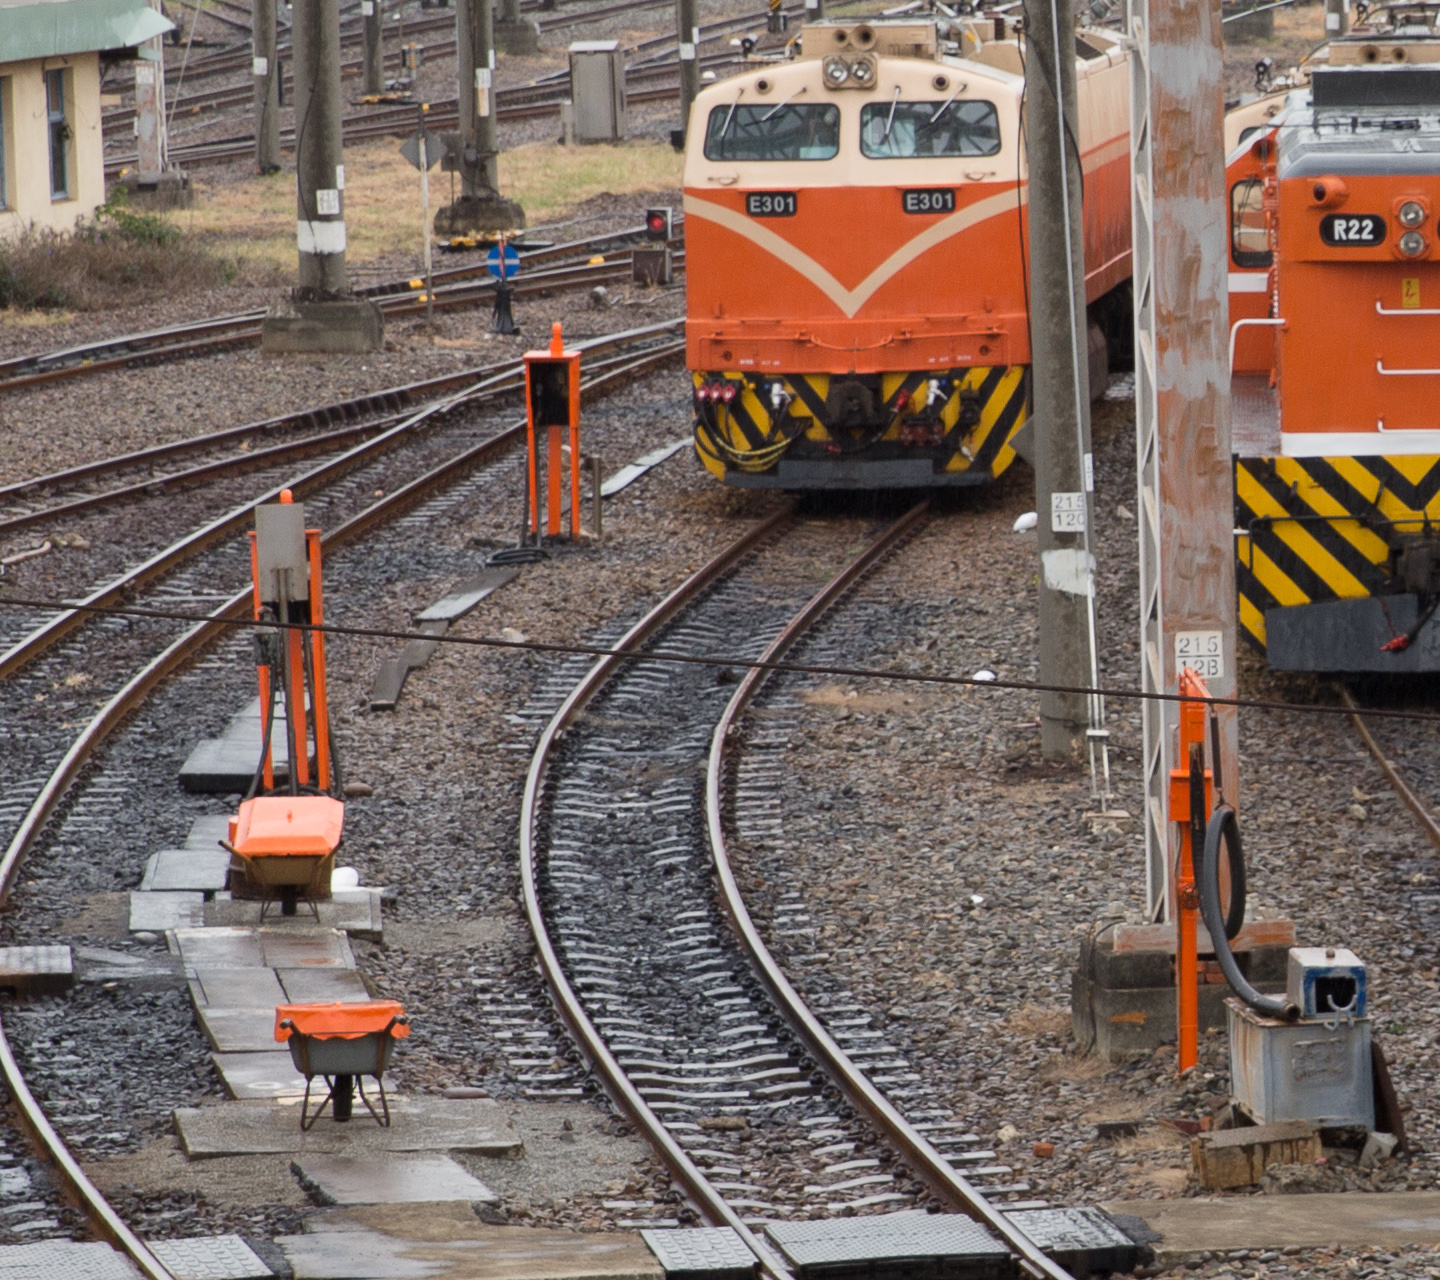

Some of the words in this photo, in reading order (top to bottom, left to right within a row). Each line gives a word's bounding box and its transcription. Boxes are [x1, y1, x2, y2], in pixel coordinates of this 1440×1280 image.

[749, 195, 795, 213] E301
[906, 191, 954, 211] E301
[1333, 219, 1375, 241] R22
[1055, 495, 1085, 509] 215
[1179, 635, 1219, 654] 215
[1181, 659, 1219, 677] 12B
